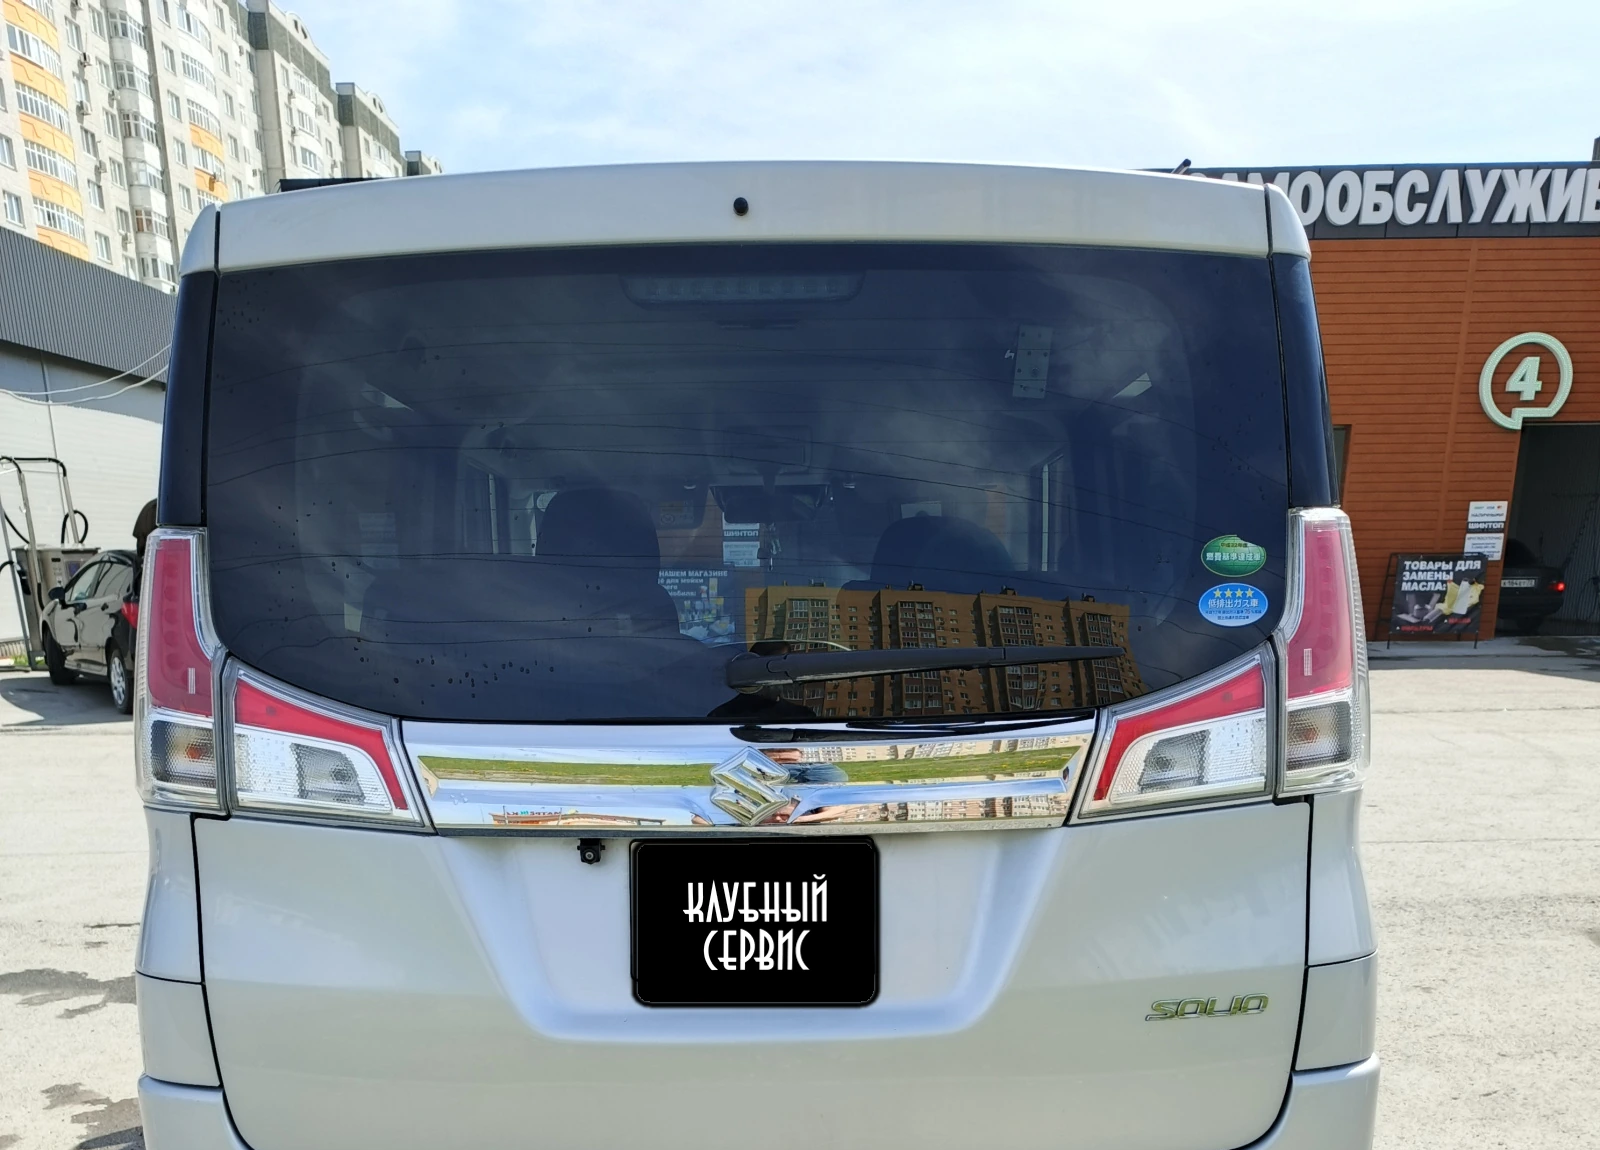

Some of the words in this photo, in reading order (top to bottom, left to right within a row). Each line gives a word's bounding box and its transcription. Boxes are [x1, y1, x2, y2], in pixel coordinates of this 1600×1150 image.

[1190, 168, 1600, 226] ООБСЛУЖИ
[1505, 356, 1542, 400] 4
[1404, 560, 1453, 571] ТОВАРЫ
[1455, 560, 1481, 571] ДЛЯ
[1402, 571, 1454, 581] ЗАМЕНЫ
[1401, 581, 1447, 592] МАСЛА:
[1145, 993, 1269, 1021] SOLIO
